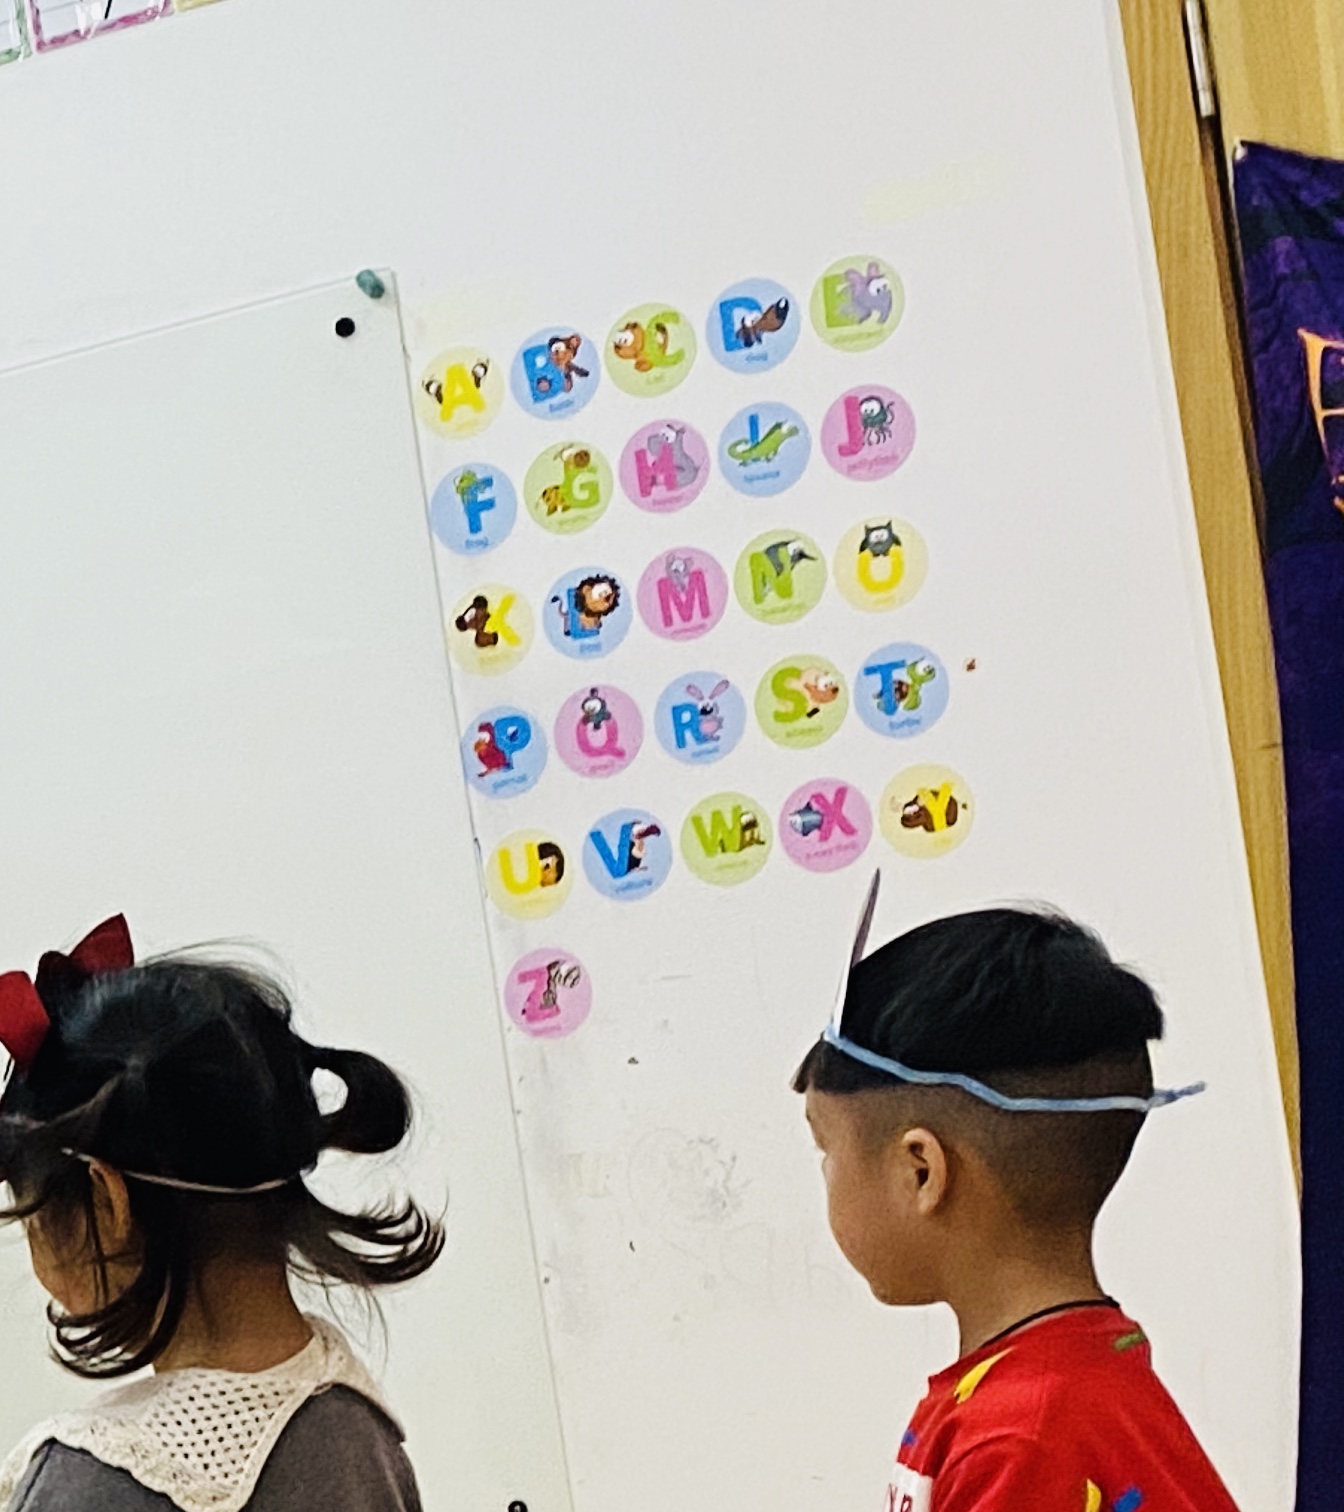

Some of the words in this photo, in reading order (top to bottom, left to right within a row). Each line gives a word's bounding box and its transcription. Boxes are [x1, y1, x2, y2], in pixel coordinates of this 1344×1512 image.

[440, 363, 486, 421] A
[522, 343, 565, 403] B
[646, 311, 686, 368] C
[719, 297, 764, 352] D
[462, 475, 496, 534] F
[634, 442, 678, 498] H
[837, 395, 864, 457] J
[656, 568, 711, 628] M
[749, 545, 794, 605] N
[494, 716, 532, 771] P
[576, 713, 626, 758] Q
[672, 703, 709, 749] R
[771, 666, 807, 723] S
[863, 659, 907, 716] T
[498, 842, 543, 895] U
[589, 822, 635, 879] V
[691, 805, 743, 858] W
[812, 786, 858, 842] X
[517, 966, 561, 1024] Z
